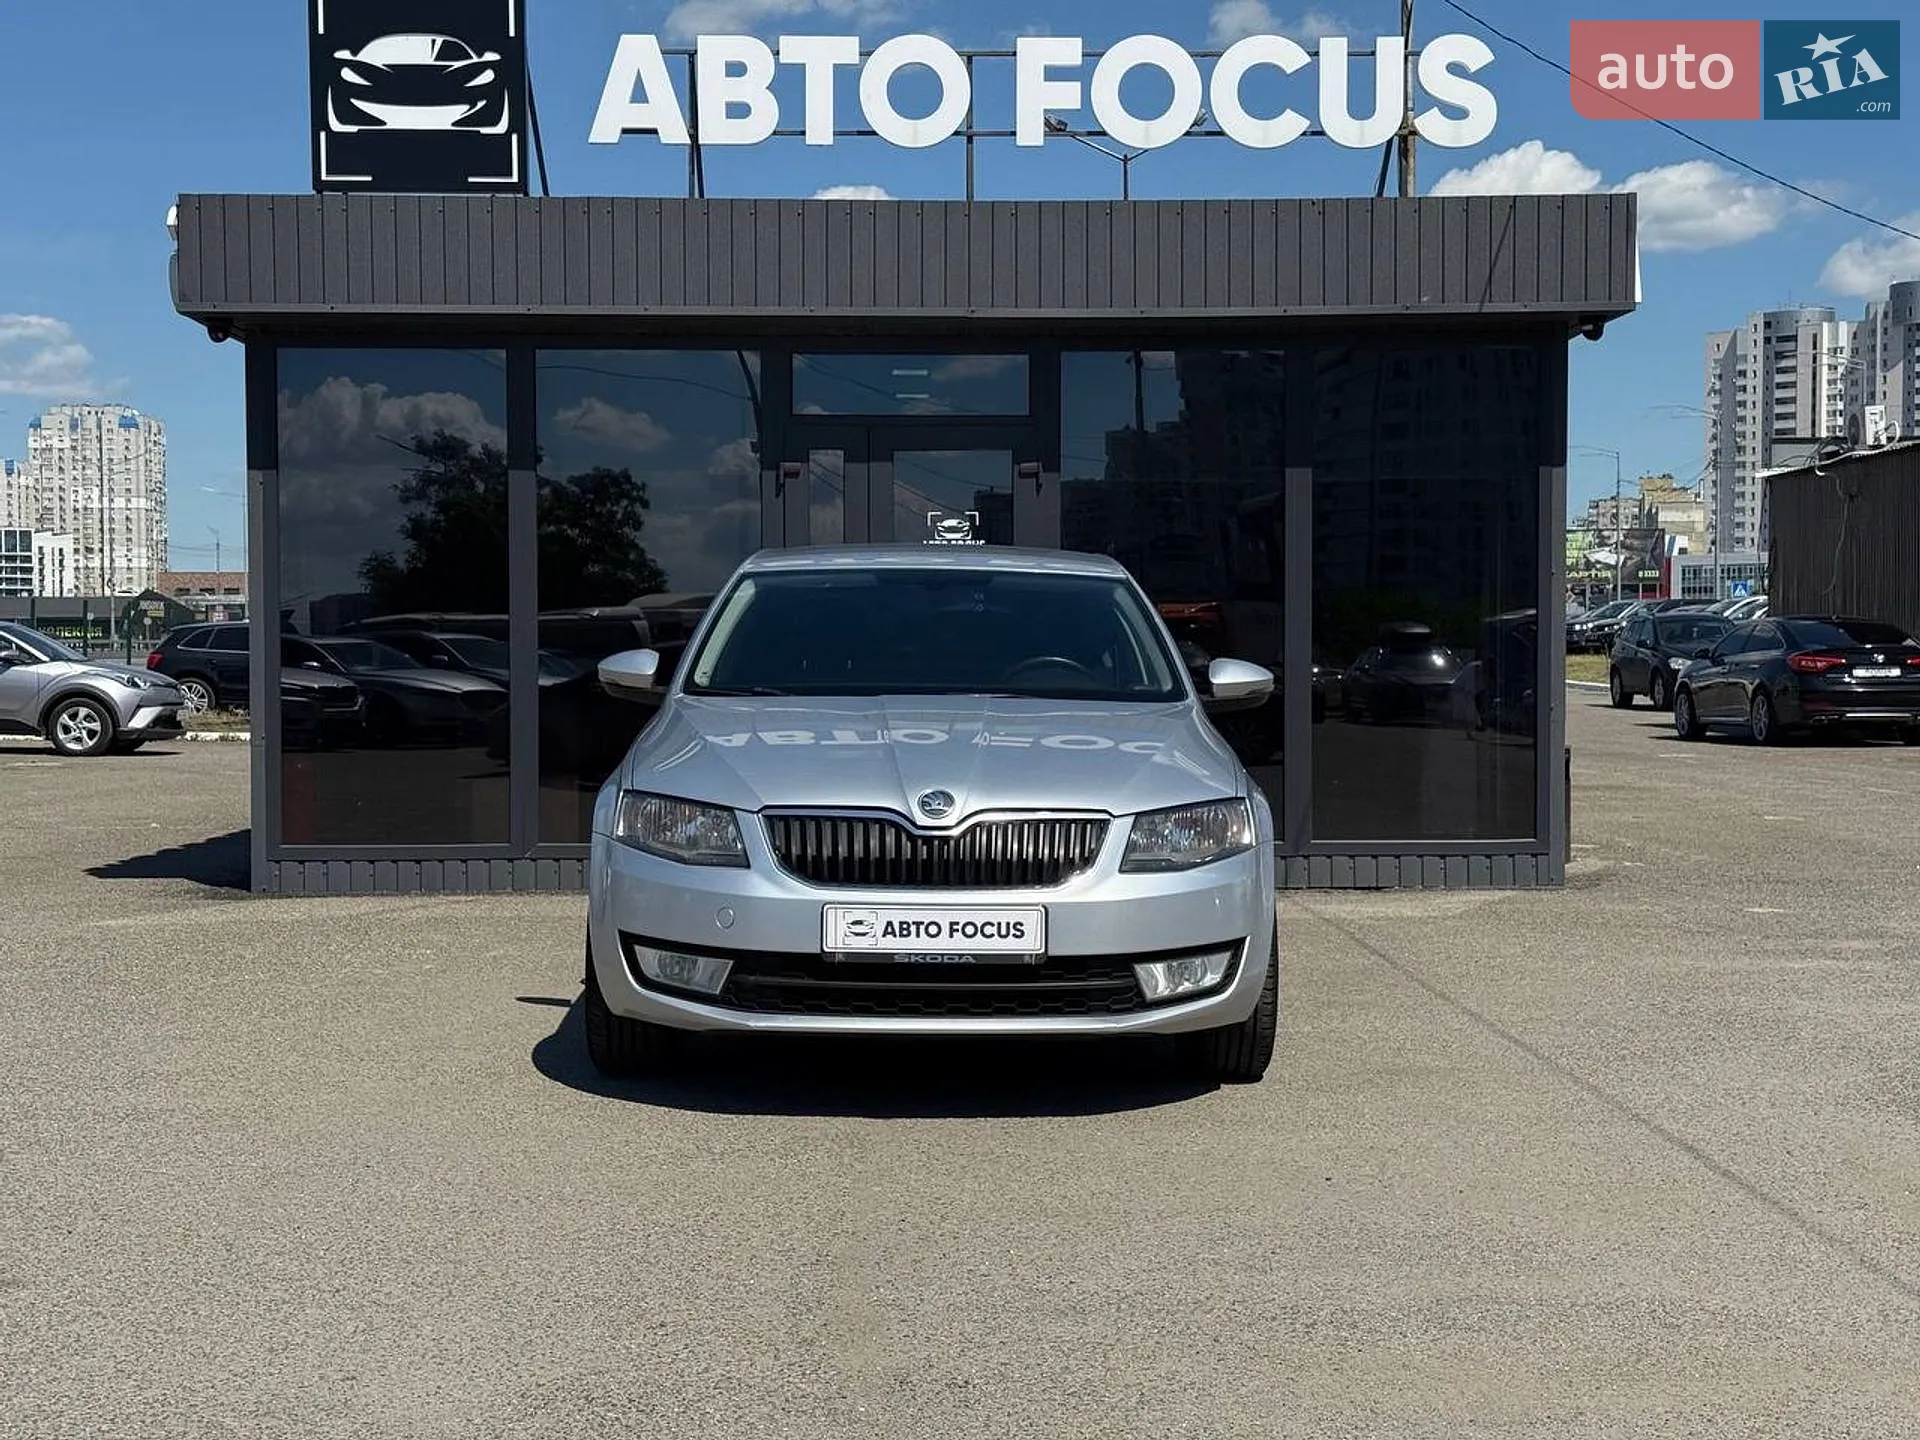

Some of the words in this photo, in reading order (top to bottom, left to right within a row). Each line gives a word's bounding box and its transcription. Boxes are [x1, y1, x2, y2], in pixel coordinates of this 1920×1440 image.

[588, 34, 971, 147] АВТО
[1015, 34, 1498, 148] FOCUS
[881, 920, 942, 939] АВТО
[949, 920, 1026, 939] FOCUS
